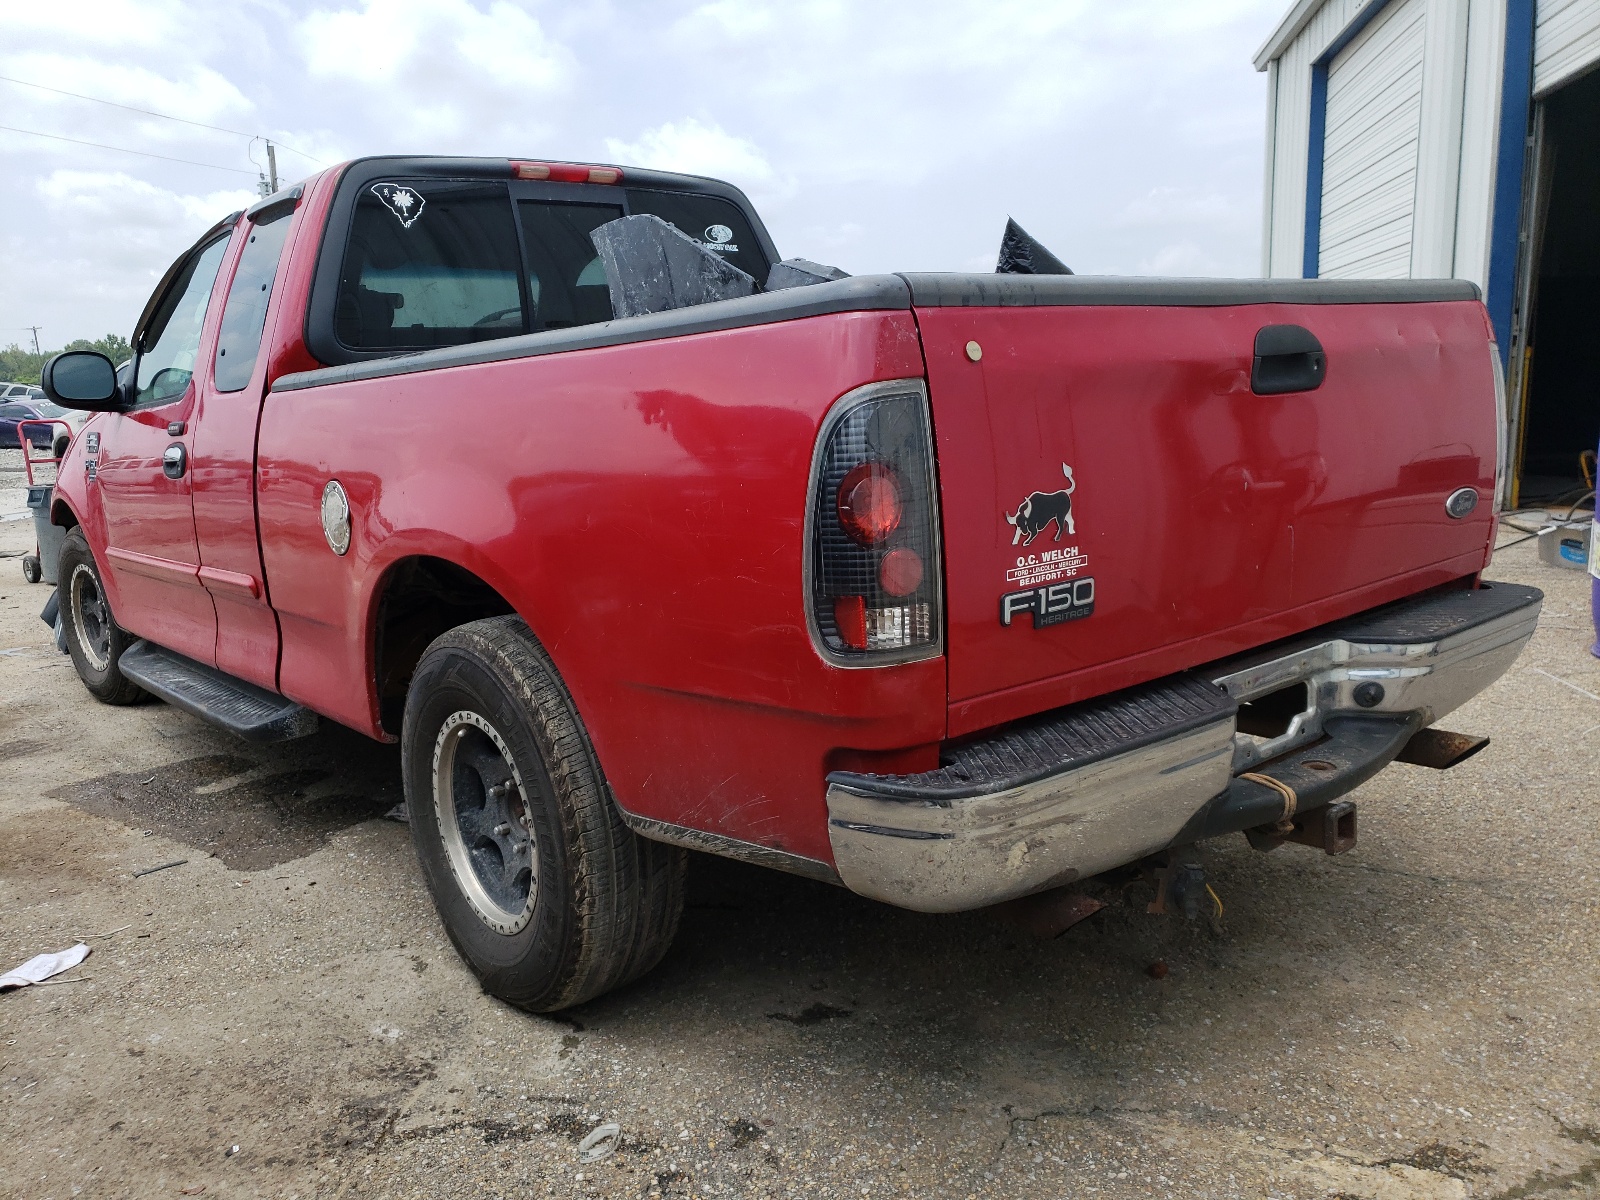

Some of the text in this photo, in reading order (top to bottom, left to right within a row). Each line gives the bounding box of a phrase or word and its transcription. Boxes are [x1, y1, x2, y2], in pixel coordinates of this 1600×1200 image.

[1016, 546, 1079, 567] O.C. WELCH
[1014, 558, 1081, 578] FORD LINCOLN MERCURY
[1019, 568, 1077, 587] BEAUFORT, SC
[1040, 607, 1090, 625] HERITAGE
